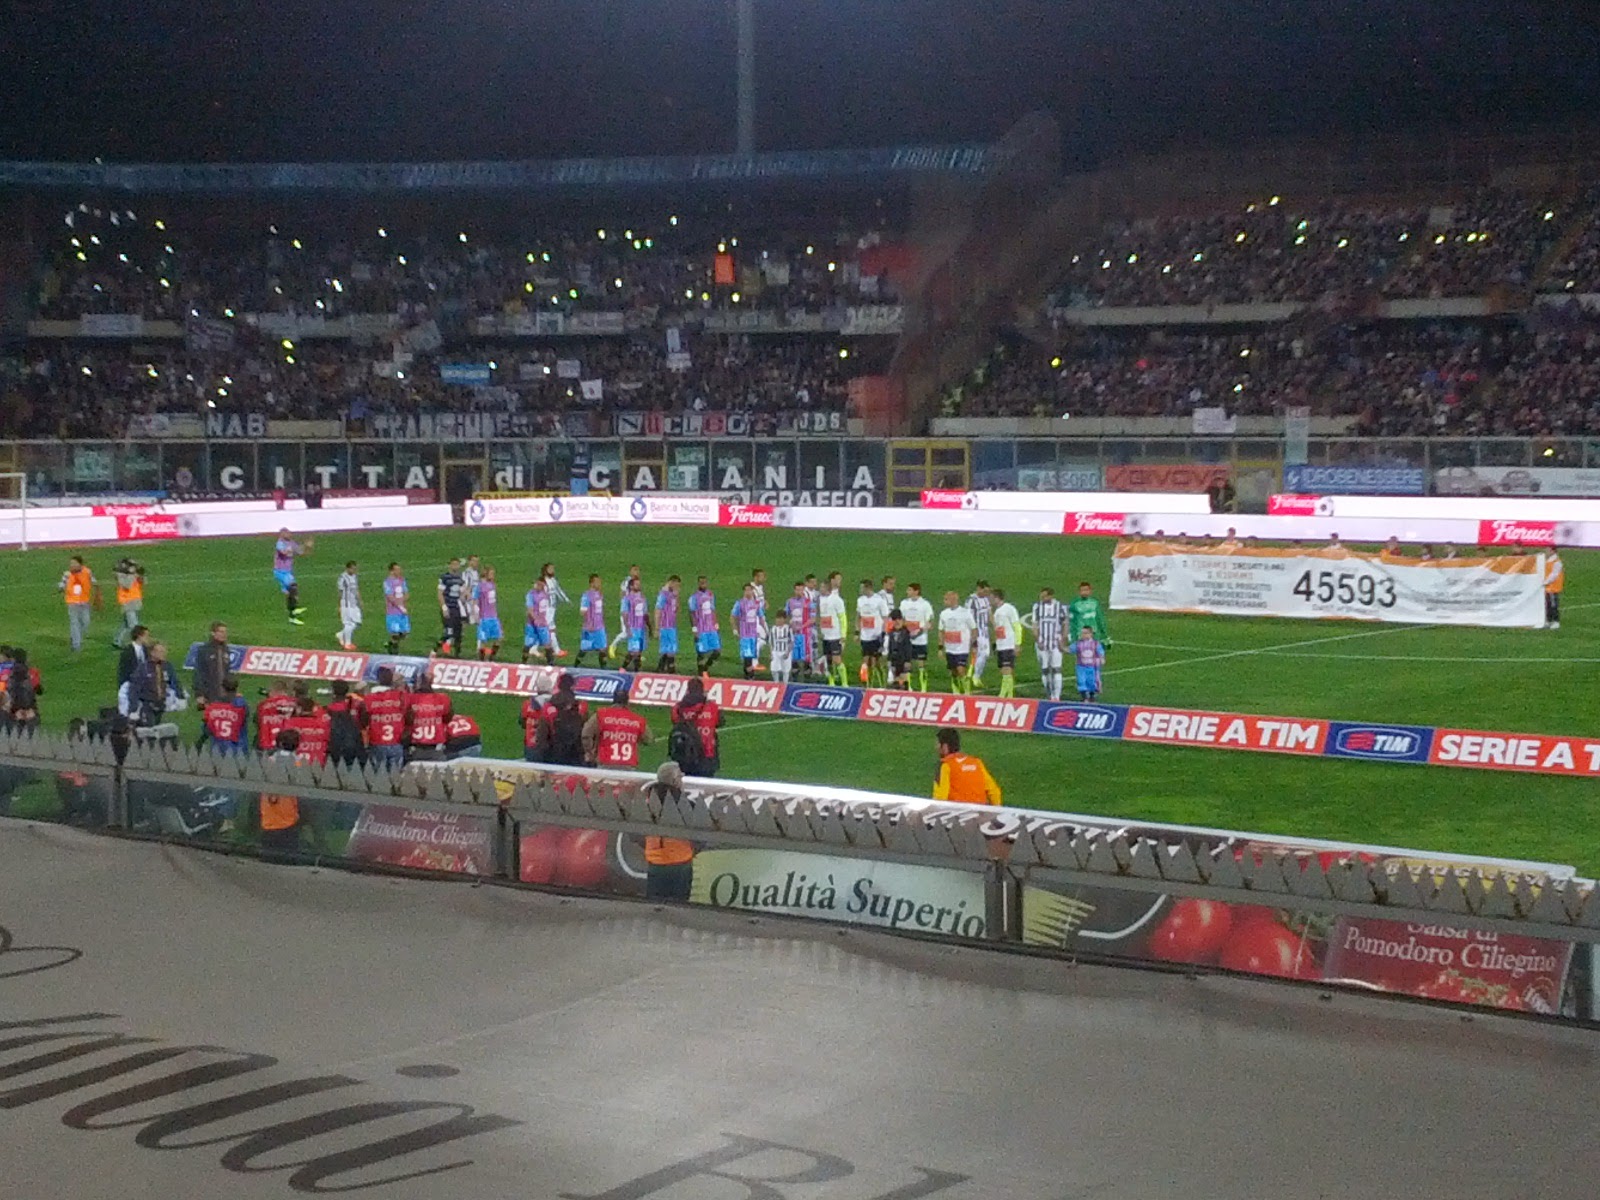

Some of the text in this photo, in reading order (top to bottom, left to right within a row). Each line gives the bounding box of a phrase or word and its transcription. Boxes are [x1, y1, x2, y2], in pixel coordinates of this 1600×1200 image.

[495, 465, 524, 489] di
[588, 465, 875, 490] CATANIA
[488, 502, 540, 514] Banca Nuova
[566, 500, 588, 511] Banca
[651, 502, 710, 514] Banca Nuova
[759, 490, 874, 508] GRAFFIO
[1293, 569, 1397, 608] 45593
[246, 651, 363, 677] SERIE A TIM
[432, 663, 490, 688] SERIE
[489, 670, 510, 689] A
[591, 678, 619, 694] TIM
[635, 677, 690, 702] SERI
[730, 684, 778, 709] TIM
[817, 693, 848, 711] TIM
[865, 693, 1030, 728] SERIE A TIM
[447, 718, 472, 734] 25
[1075, 712, 1110, 730] TIM
[382, 725, 394, 741] 3
[603, 731, 639, 742] PHOTO
[1131, 712, 1320, 750] SERIE A TIM
[610, 742, 633, 761] 19
[1374, 734, 1411, 753] TIM
[1438, 734, 1541, 767] SERIE
[1541, 740, 1575, 769] A
[362, 814, 428, 843] Pomodoro
[709, 870, 837, 911] Qualità
[1344, 926, 1556, 978] Pomodoro Ciliegino
